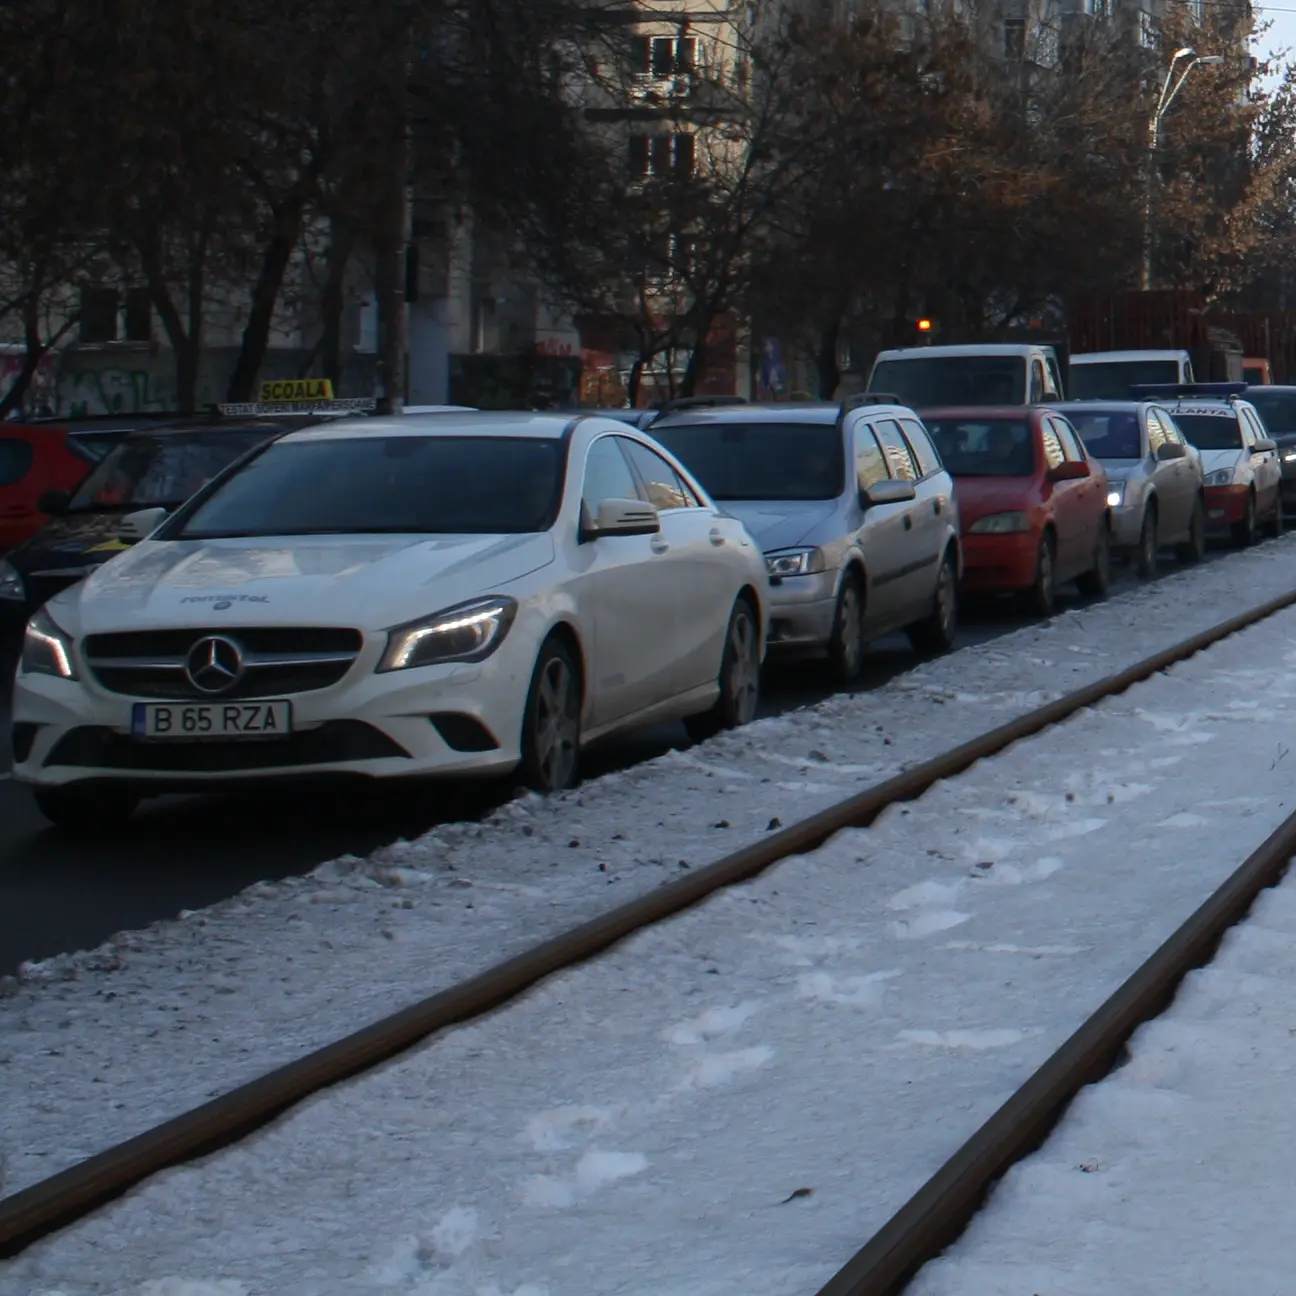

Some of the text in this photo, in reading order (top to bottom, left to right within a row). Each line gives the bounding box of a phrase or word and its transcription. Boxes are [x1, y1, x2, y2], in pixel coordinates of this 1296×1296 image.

[261, 381, 327, 400] SCOALA
[154, 705, 277, 733] B 65 RZA
